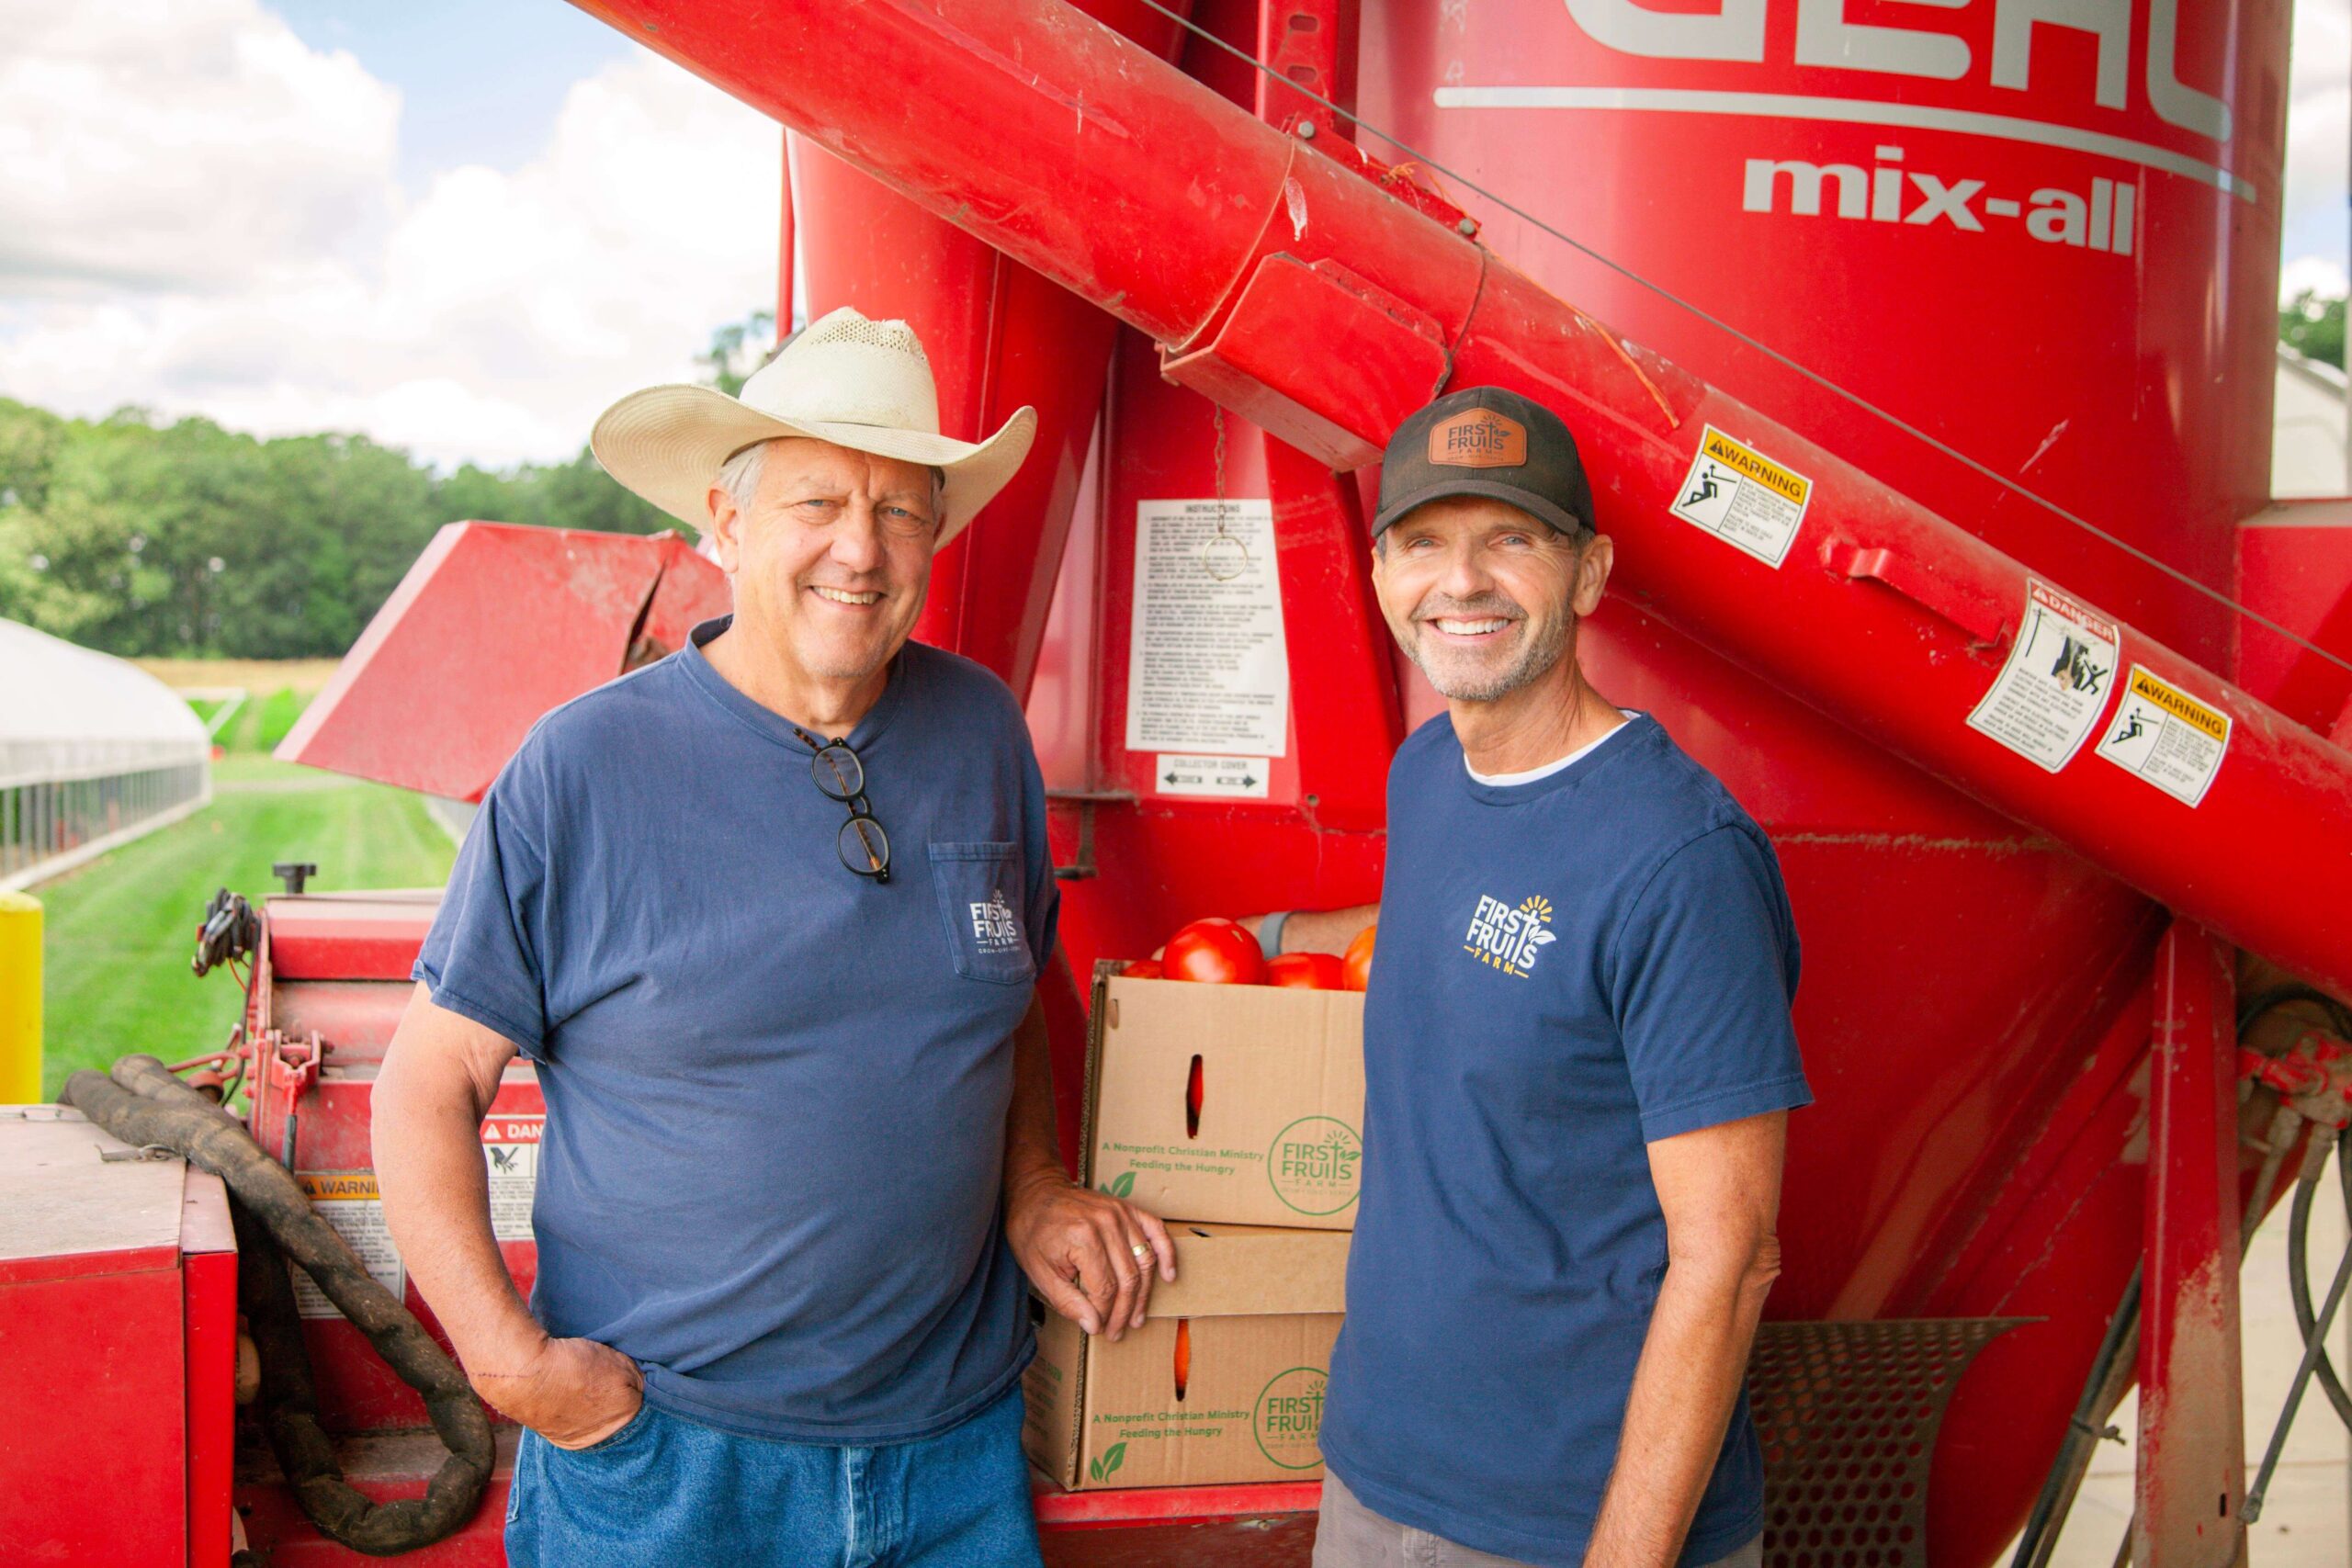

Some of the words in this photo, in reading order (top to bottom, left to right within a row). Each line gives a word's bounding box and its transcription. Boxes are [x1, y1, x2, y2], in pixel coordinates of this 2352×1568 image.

[1742, 145, 2136, 257] mix-all
[1448, 422, 1497, 439] FIRST
[1724, 445, 1802, 498] WARNING
[2048, 595, 2114, 641] DANGER
[2150, 684, 2222, 735] WARNING
[969, 900, 1002, 920] FIRST
[1474, 894, 1541, 934] FIRST
[1474, 947, 1514, 976] FARM
[507, 1123, 544, 1139] DAN
[1102, 1143, 1110, 1151] A
[1114, 1143, 1166, 1156] Nonprofit
[1168, 1145, 1216, 1157] Christian
[1219, 1149, 1264, 1162] Ministry
[1283, 1141, 1343, 1161] FIRST
[1129, 1159, 1172, 1172] Feeding
[1175, 1162, 1193, 1172] the
[1195, 1164, 1236, 1176] Hungry
[320, 1180, 379, 1194] WARNI
[1295, 1179, 1337, 1187] FARM
[1268, 1391, 1324, 1414] FIRST
[1092, 1415, 1101, 1423] A
[1103, 1412, 1155, 1425] Nonprofit
[1158, 1411, 1204, 1422] Christian
[1207, 1409, 1250, 1421] Ministry
[1119, 1427, 1161, 1439] Feeding
[1164, 1427, 1182, 1437] the
[1184, 1427, 1223, 1438] Hungry
